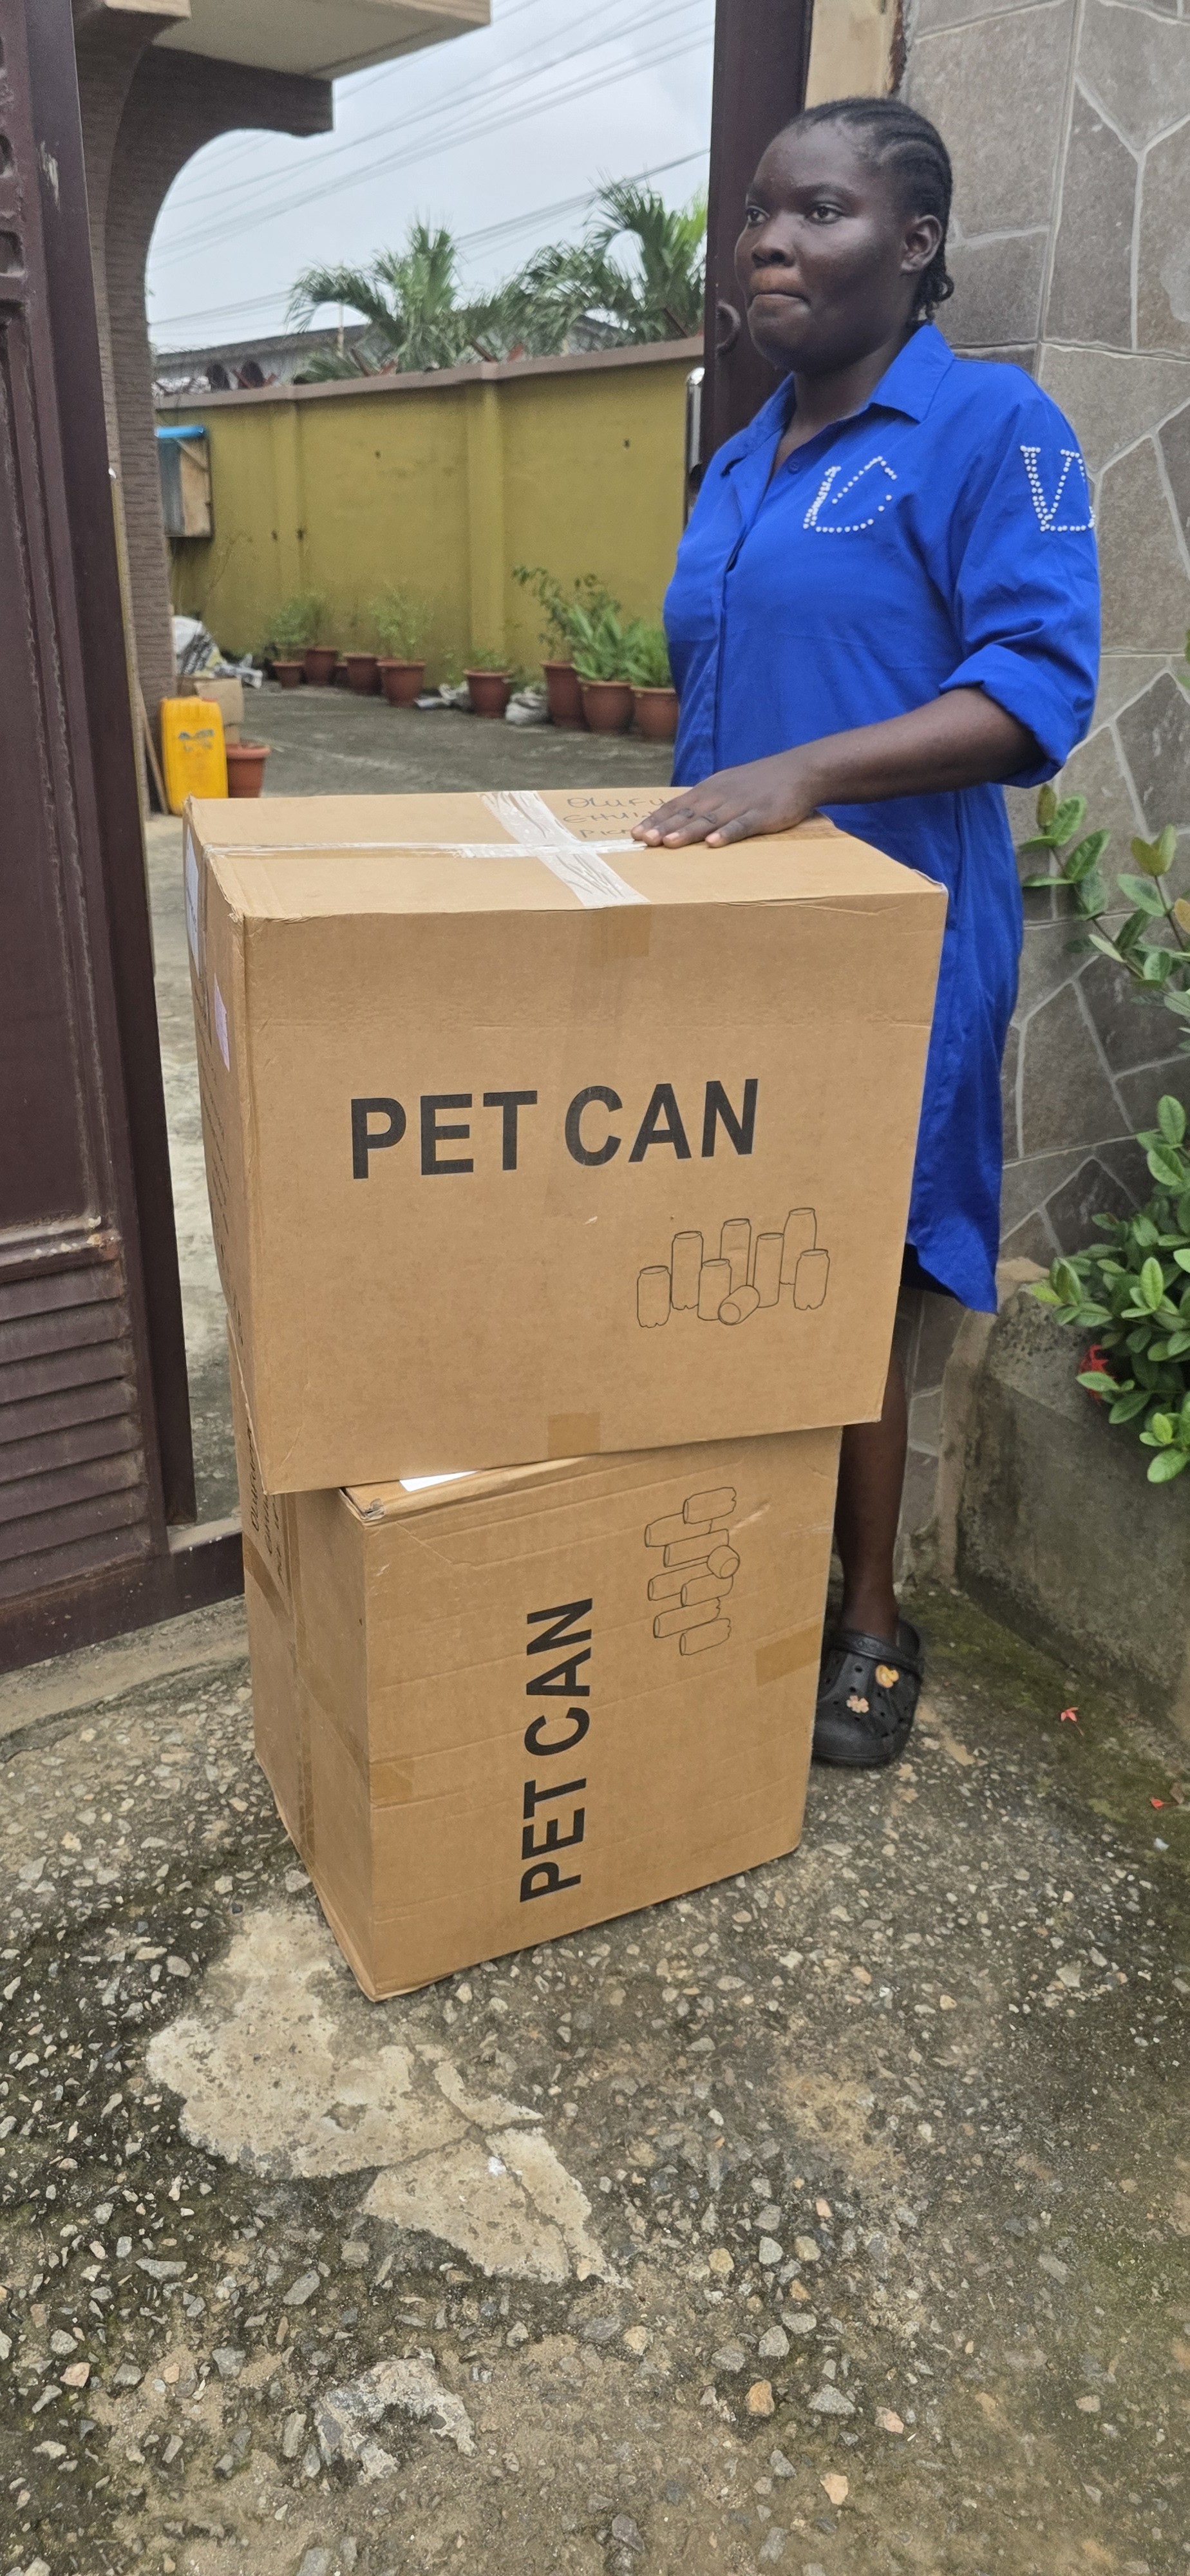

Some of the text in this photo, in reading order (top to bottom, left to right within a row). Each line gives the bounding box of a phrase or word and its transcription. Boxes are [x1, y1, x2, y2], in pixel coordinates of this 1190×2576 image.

[351, 1078, 759, 1180] PET CAN
[520, 1598, 593, 1903] PET CAN
